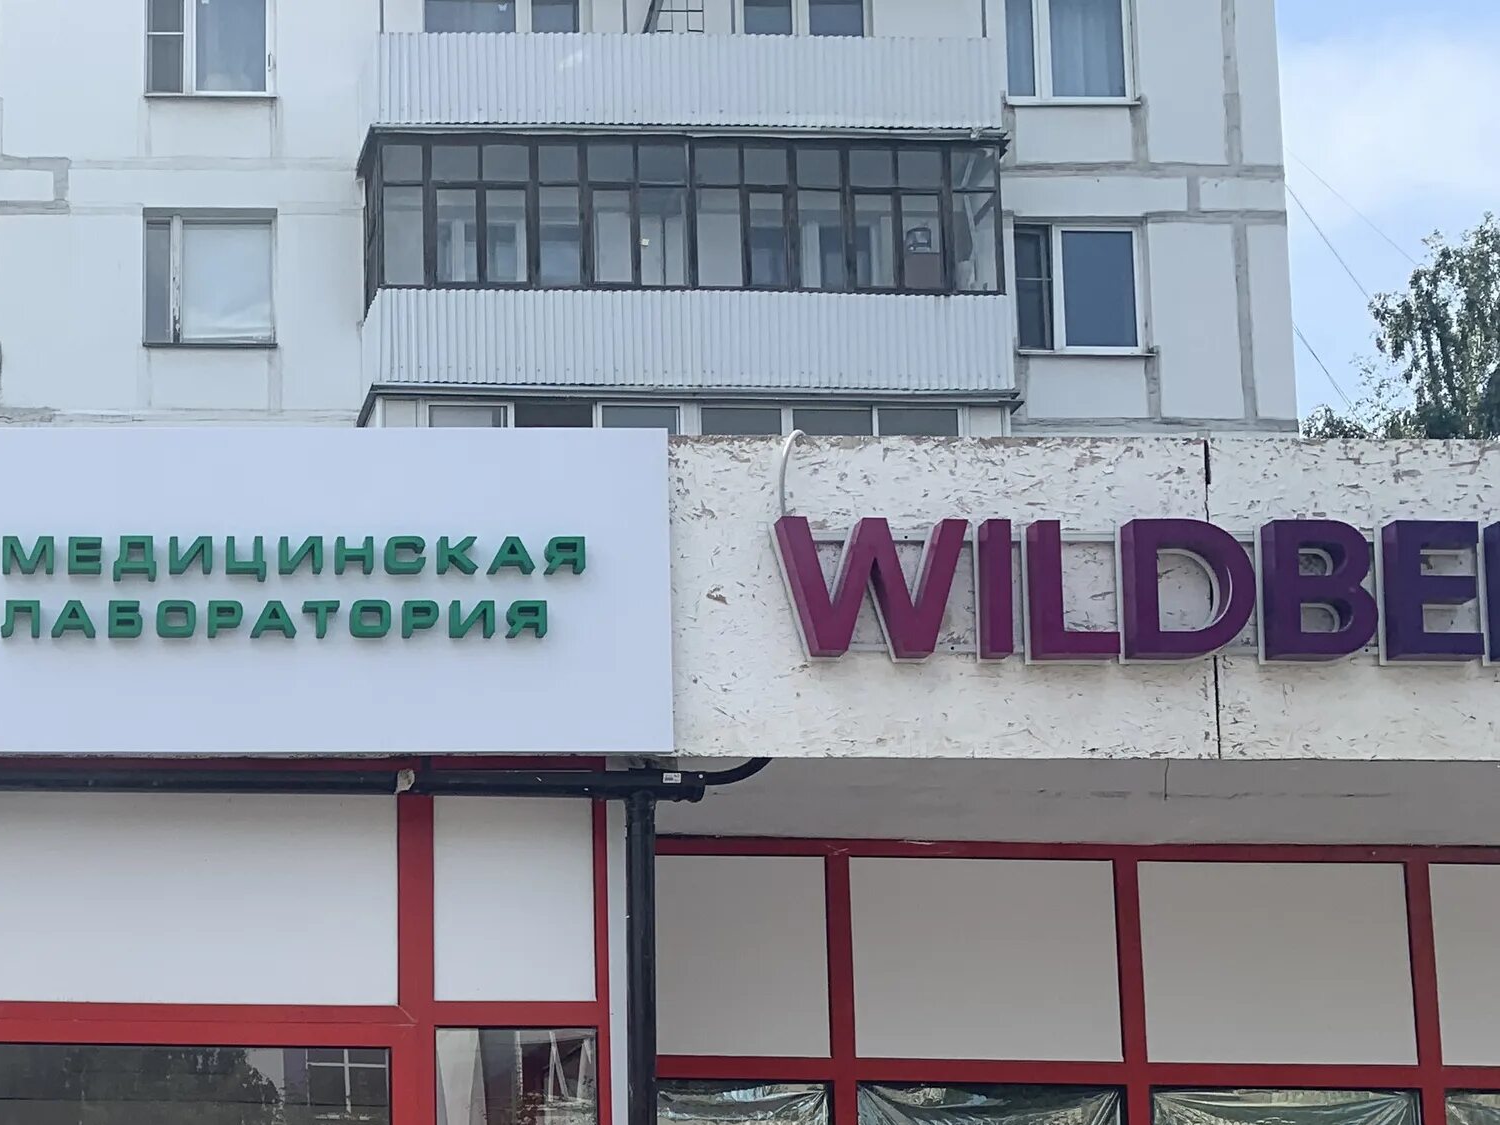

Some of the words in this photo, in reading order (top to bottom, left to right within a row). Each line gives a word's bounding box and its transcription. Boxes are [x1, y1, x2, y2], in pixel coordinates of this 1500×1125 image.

[1, 535, 586, 582] МЕДИЦИНСКАЯ
[772, 516, 1500, 664] WILDBE
[0, 600, 548, 640] ЛАБОРАТОРИЯ
